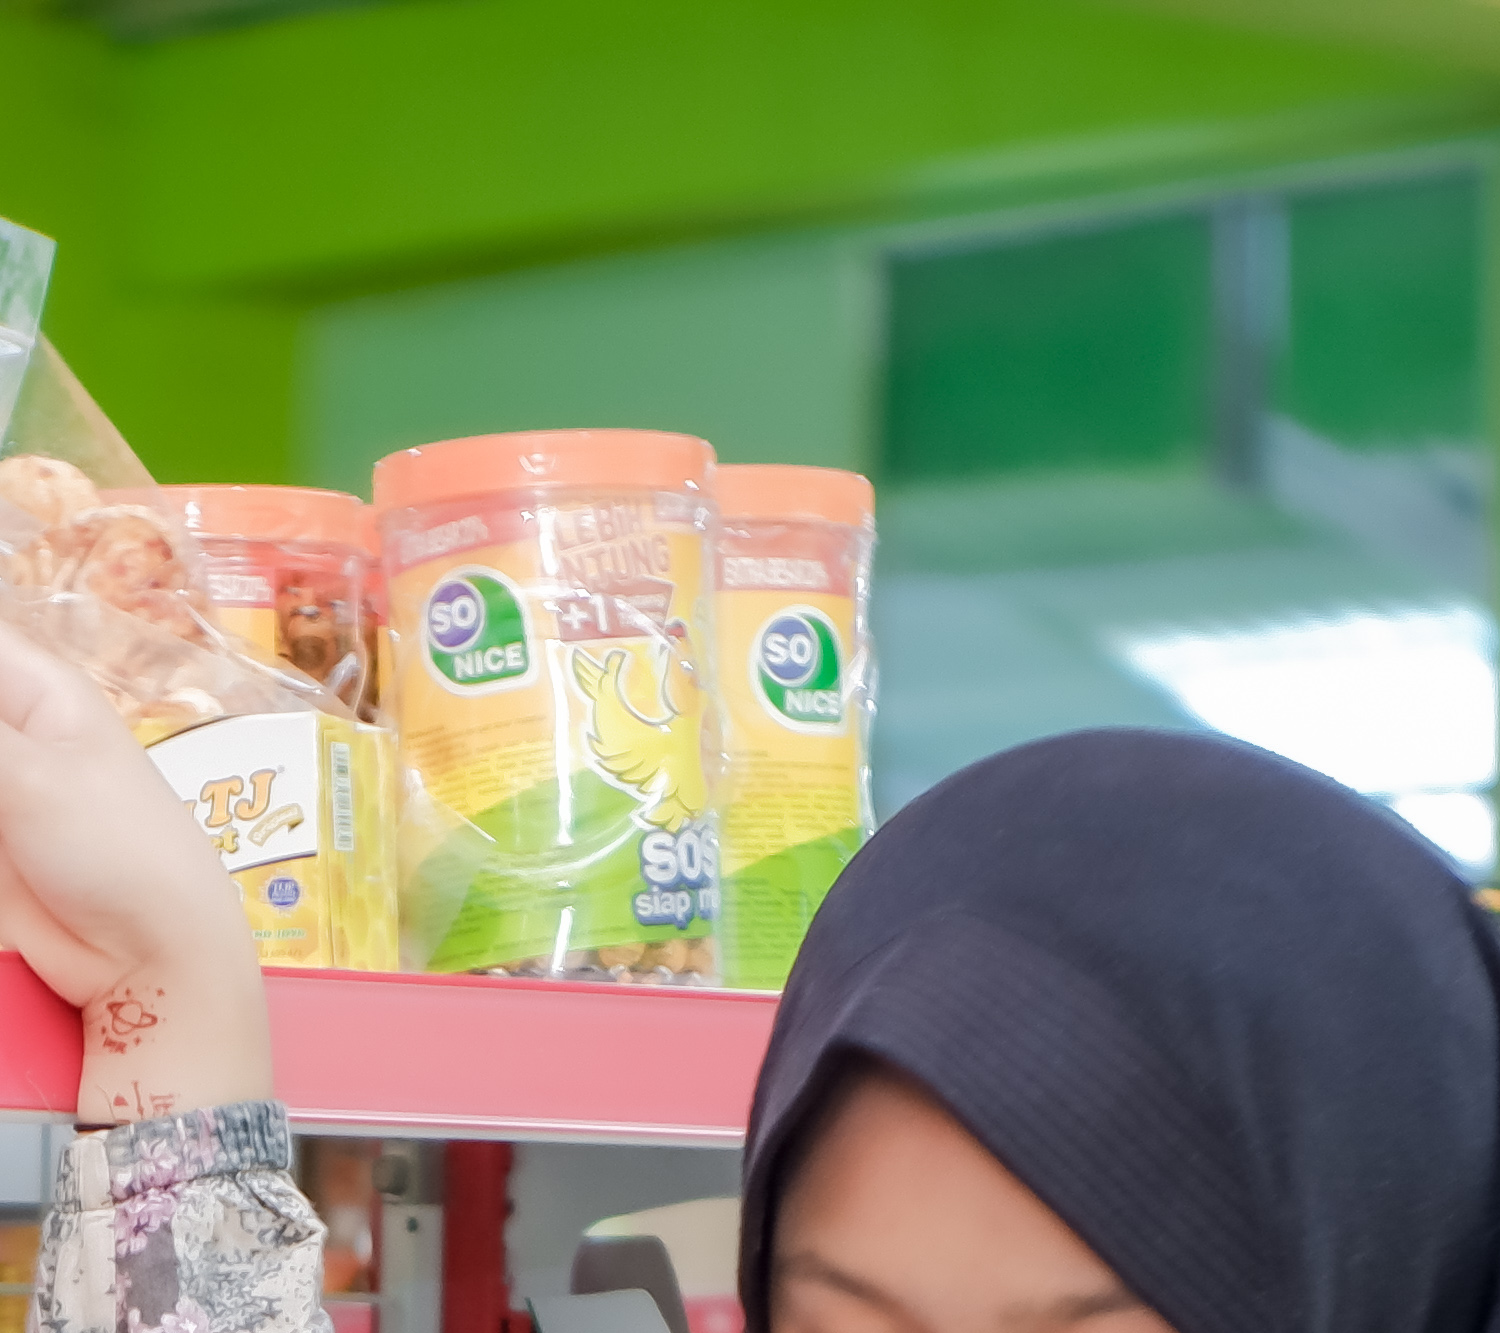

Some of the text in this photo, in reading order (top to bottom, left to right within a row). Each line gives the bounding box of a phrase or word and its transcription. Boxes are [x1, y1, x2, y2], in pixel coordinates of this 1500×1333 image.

[430, 595, 477, 633] SO
[454, 642, 523, 678] NICE
[765, 634, 812, 664] SO
[635, 888, 690, 922] siap
